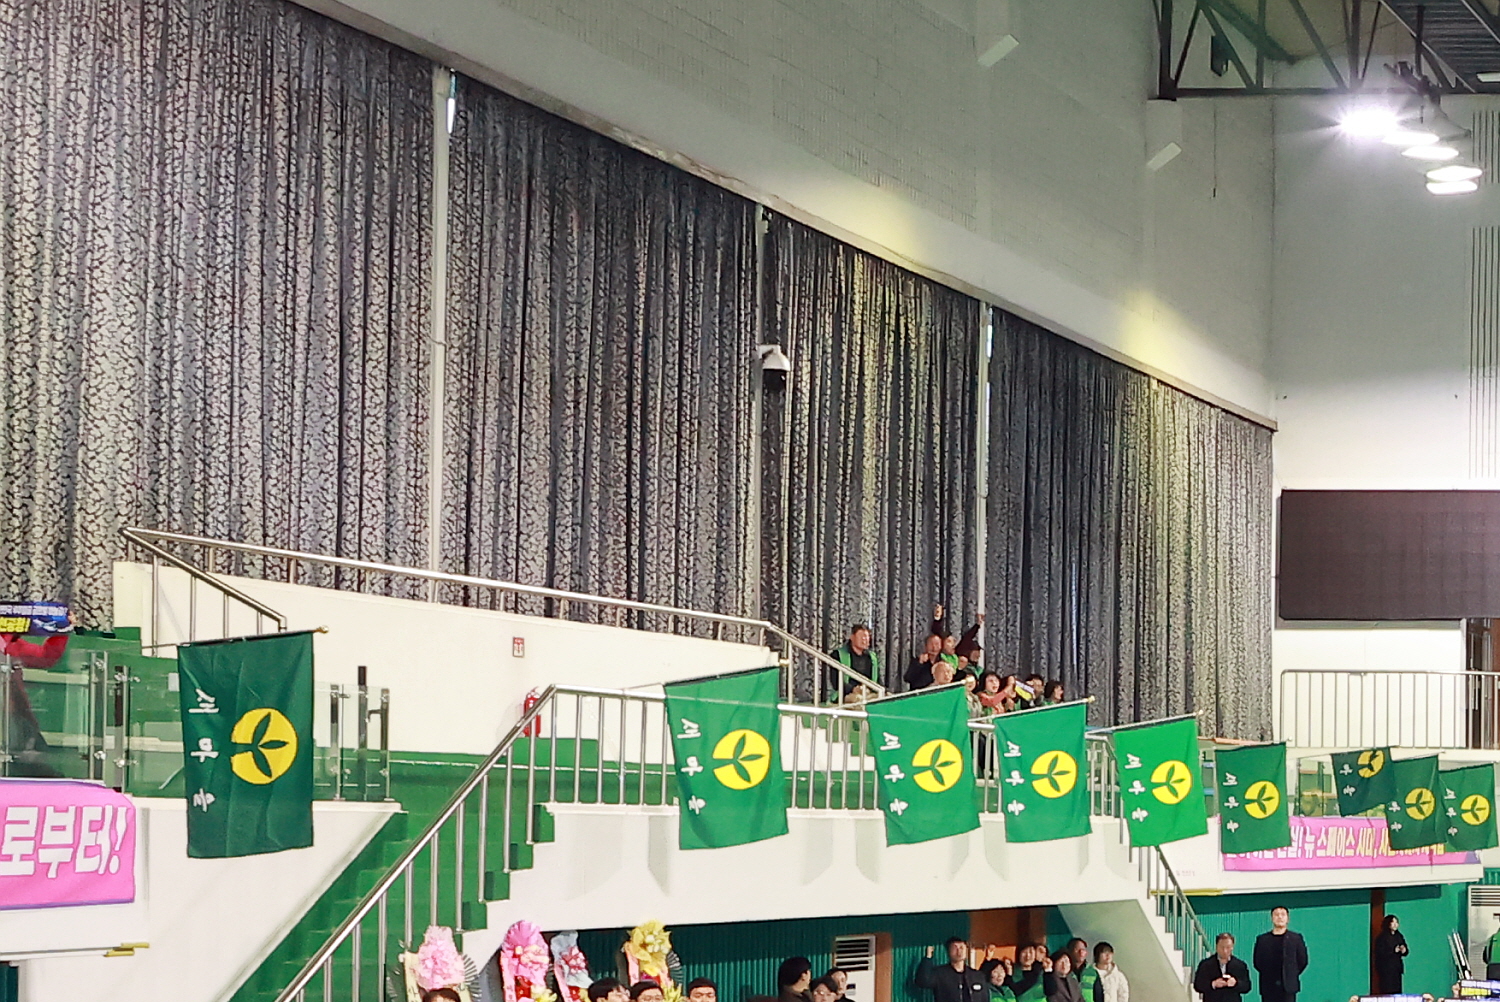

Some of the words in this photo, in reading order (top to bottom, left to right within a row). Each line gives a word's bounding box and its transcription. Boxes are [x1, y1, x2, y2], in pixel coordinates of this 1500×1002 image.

[1304, 826, 1316, 858] 뉴
[1316, 826, 1355, 857] 스페이스
[1356, 827, 1377, 859] 시대,
